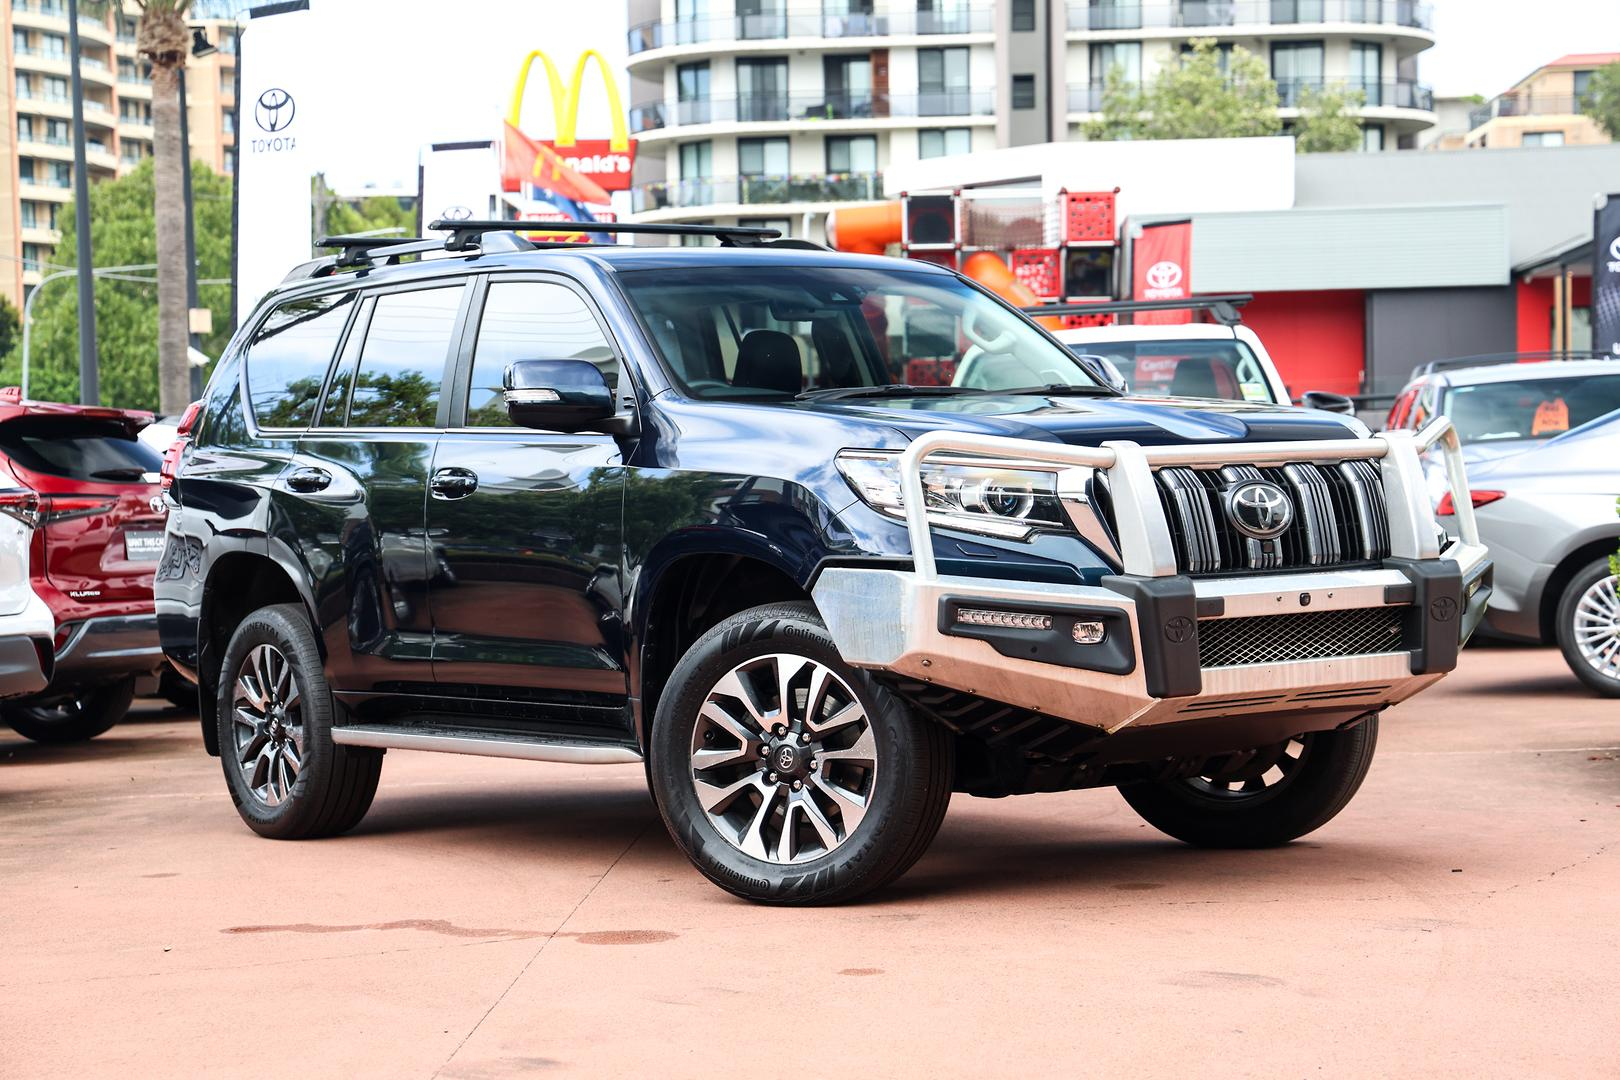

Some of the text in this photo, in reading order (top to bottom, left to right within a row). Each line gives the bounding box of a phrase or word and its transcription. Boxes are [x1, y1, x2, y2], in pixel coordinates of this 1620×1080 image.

[251, 137, 296, 153] TOYOTA
[565, 154, 631, 173] nald's
[783, 625, 839, 651] Continenta
[713, 861, 772, 890] Continental
